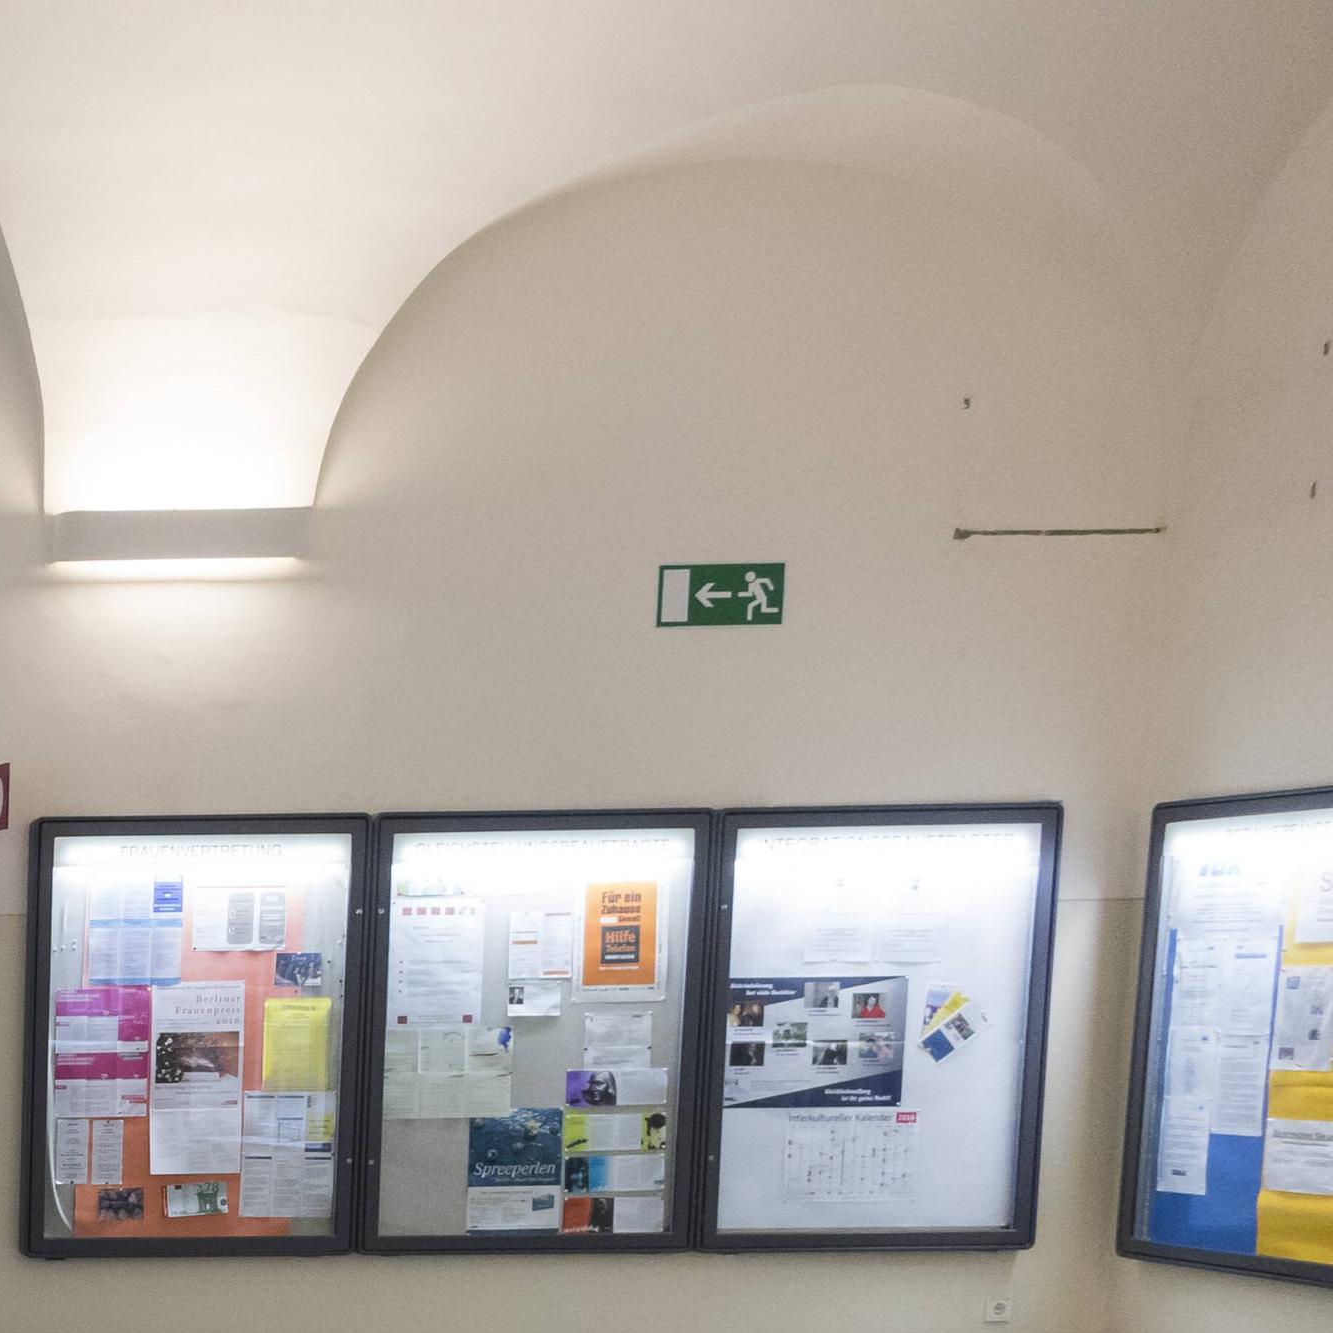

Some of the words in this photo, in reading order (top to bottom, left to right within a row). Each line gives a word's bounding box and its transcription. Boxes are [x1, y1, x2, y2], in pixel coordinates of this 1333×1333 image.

[601, 891, 621, 903] Für
[624, 892, 641, 903] ein
[601, 905, 641, 914] Zuhause
[606, 931, 635, 943] Hilfe
[606, 945, 635, 953] Telefon
[196, 994, 241, 1003] Berliner
[175, 1006, 241, 1017] Frauenpreis
[788, 1112, 853, 1122] Interkultureller
[855, 1112, 893, 1122] Kalender
[473, 1161, 556, 1178] Spreeperlen
